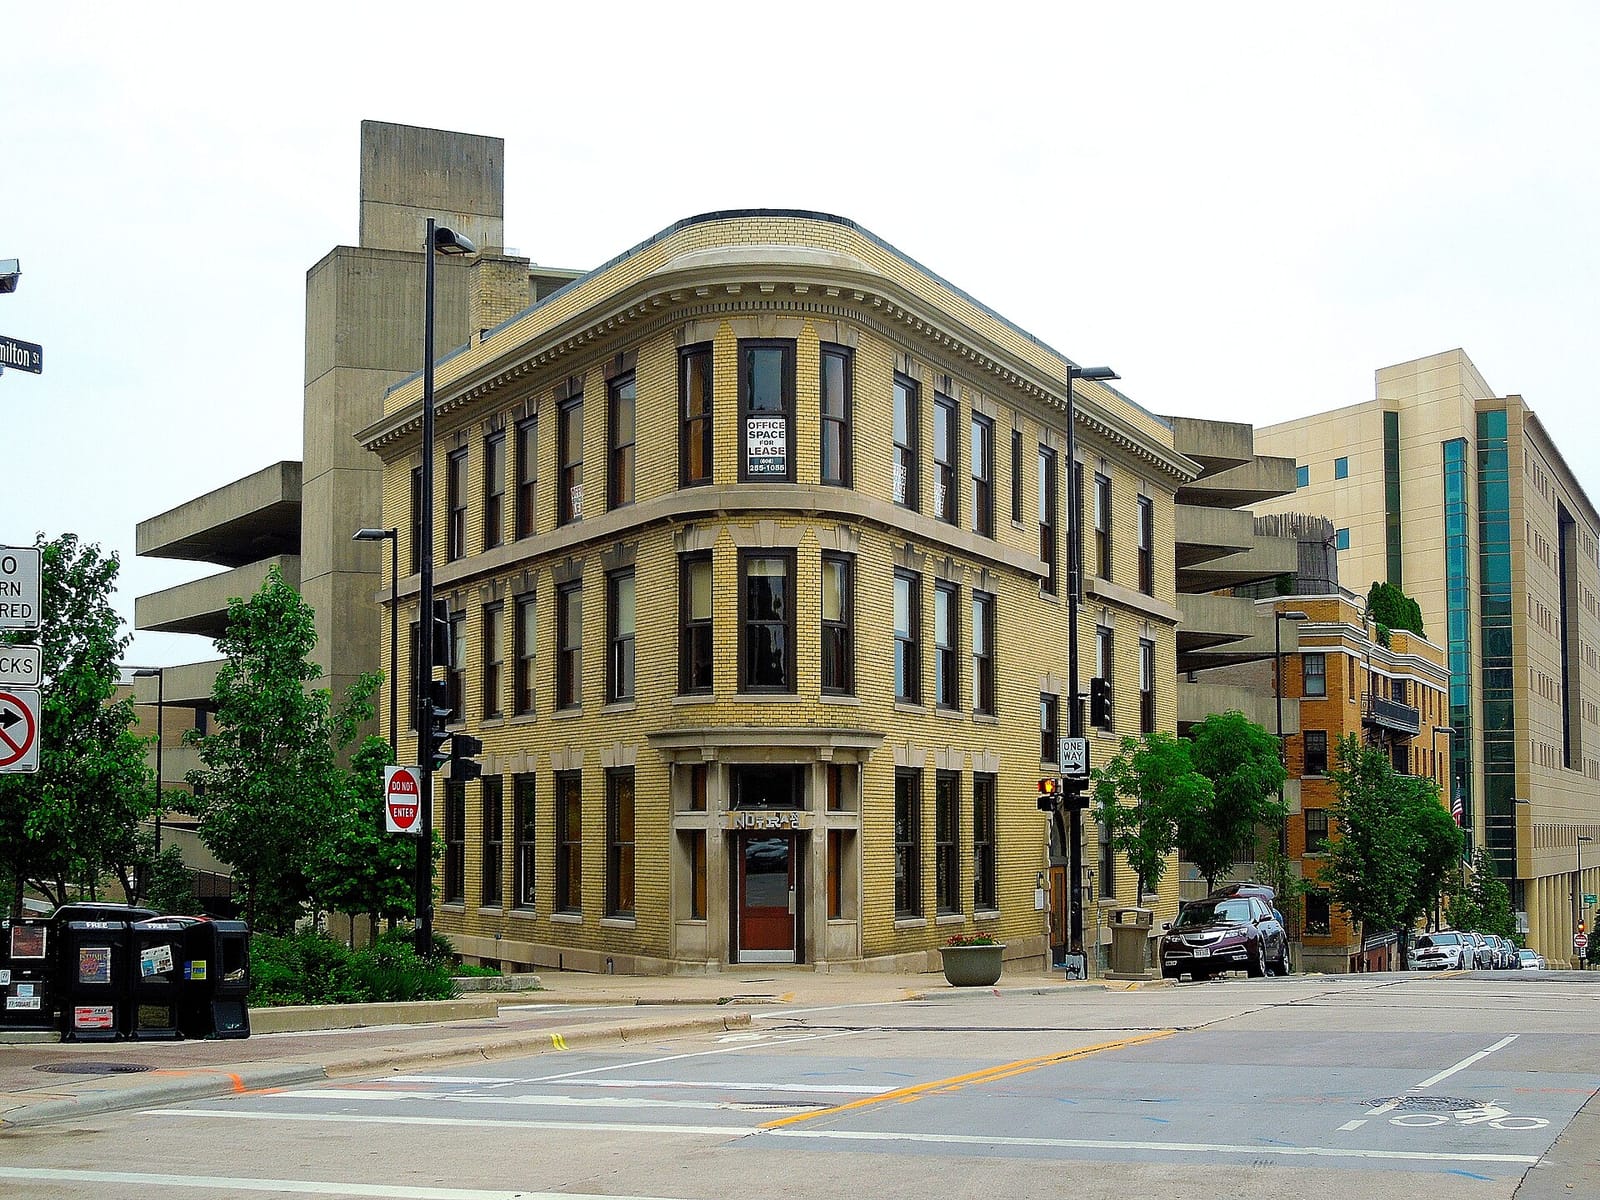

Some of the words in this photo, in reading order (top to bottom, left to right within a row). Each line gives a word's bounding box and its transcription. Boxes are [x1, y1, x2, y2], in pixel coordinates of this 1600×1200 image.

[748, 421, 785, 430] OFFICE
[748, 430, 785, 439] SPACE
[748, 446, 785, 456] LEASE
[0, 603, 32, 619] RED
[1063, 741, 1083, 751] ONE
[1063, 751, 1083, 761] WAY
[391, 781, 401, 791] DO
[401, 782, 414, 792] NOT
[393, 807, 414, 818] ENTER
[85, 921, 108, 929] FREE
